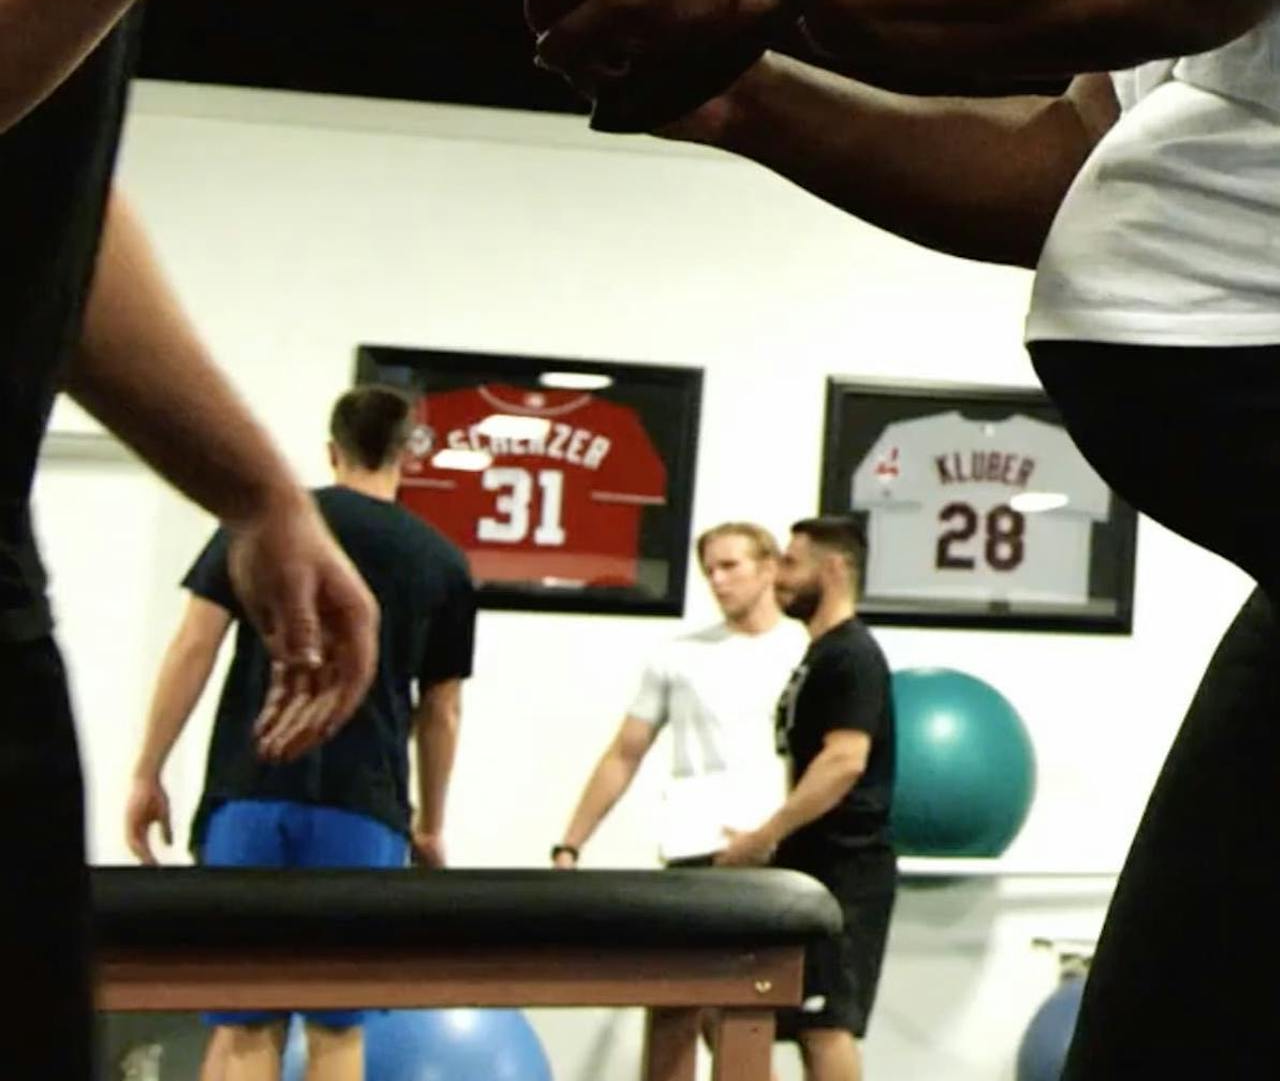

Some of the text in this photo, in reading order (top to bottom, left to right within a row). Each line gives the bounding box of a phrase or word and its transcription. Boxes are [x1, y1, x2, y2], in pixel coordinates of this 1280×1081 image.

[935, 450, 1035, 486] KLUBER
[476, 468, 566, 546] 31
[936, 502, 1026, 572] 28
